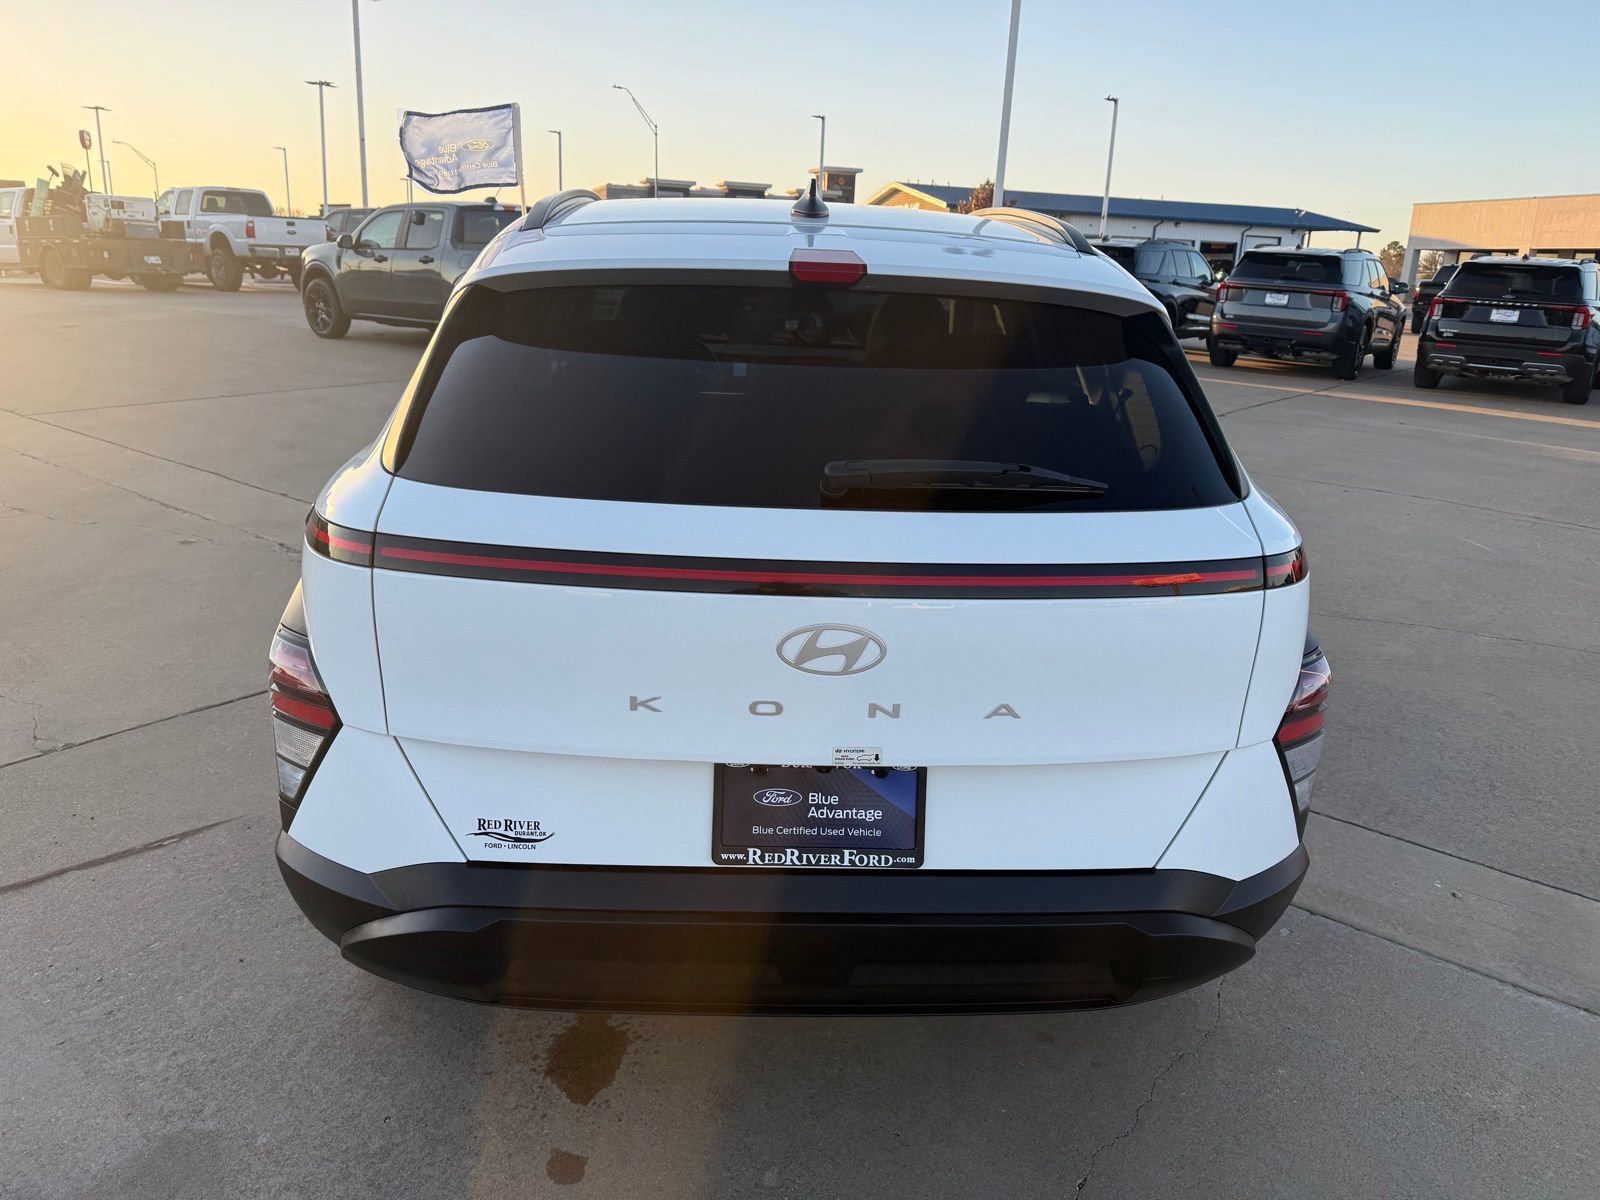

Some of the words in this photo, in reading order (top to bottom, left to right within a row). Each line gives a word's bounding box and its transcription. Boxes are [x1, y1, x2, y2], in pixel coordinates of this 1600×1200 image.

[629, 695, 1021, 719] KONA
[762, 790, 793, 804] Ford
[808, 792, 839, 805] Blue
[807, 806, 883, 822] Advantage
[752, 825, 774, 835] Blue
[776, 826, 818, 836] Certified
[820, 827, 845, 836] Used
[847, 827, 882, 837] Vehicle
